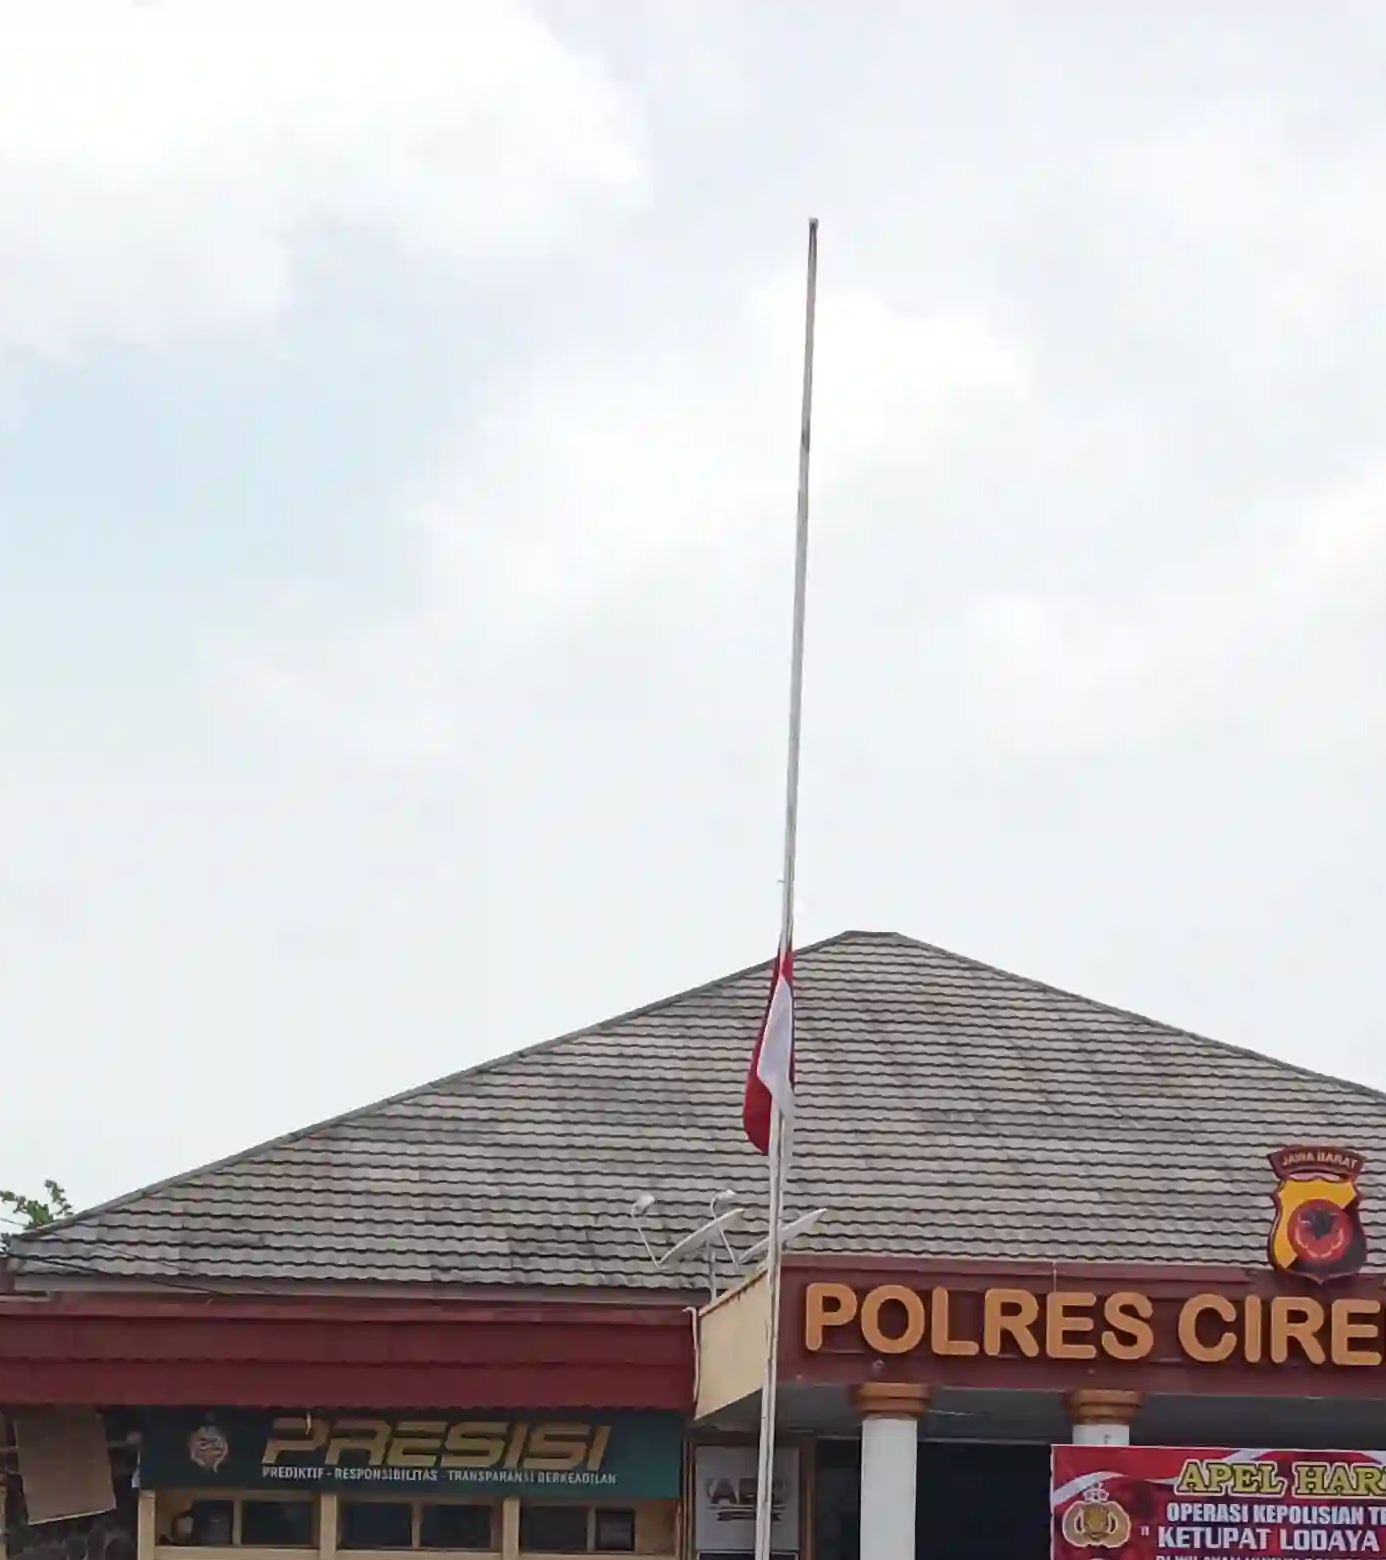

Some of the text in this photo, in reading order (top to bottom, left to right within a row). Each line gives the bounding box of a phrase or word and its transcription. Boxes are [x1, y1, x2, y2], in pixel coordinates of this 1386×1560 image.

[805, 1282, 1154, 1361] POLRES
[261, 1417, 612, 1471] PRESISI
[262, 1465, 325, 1481] PREDIKTIF
[334, 1467, 438, 1482] RESPONSIBILITAS
[1174, 1459, 1287, 1497] APEL
[1166, 1502, 1248, 1523] OPERASI
[1254, 1504, 1363, 1525] KEPOLISIAN
[1158, 1526, 1271, 1549] KETUPAT
[1279, 1528, 1380, 1551] LODAYA
